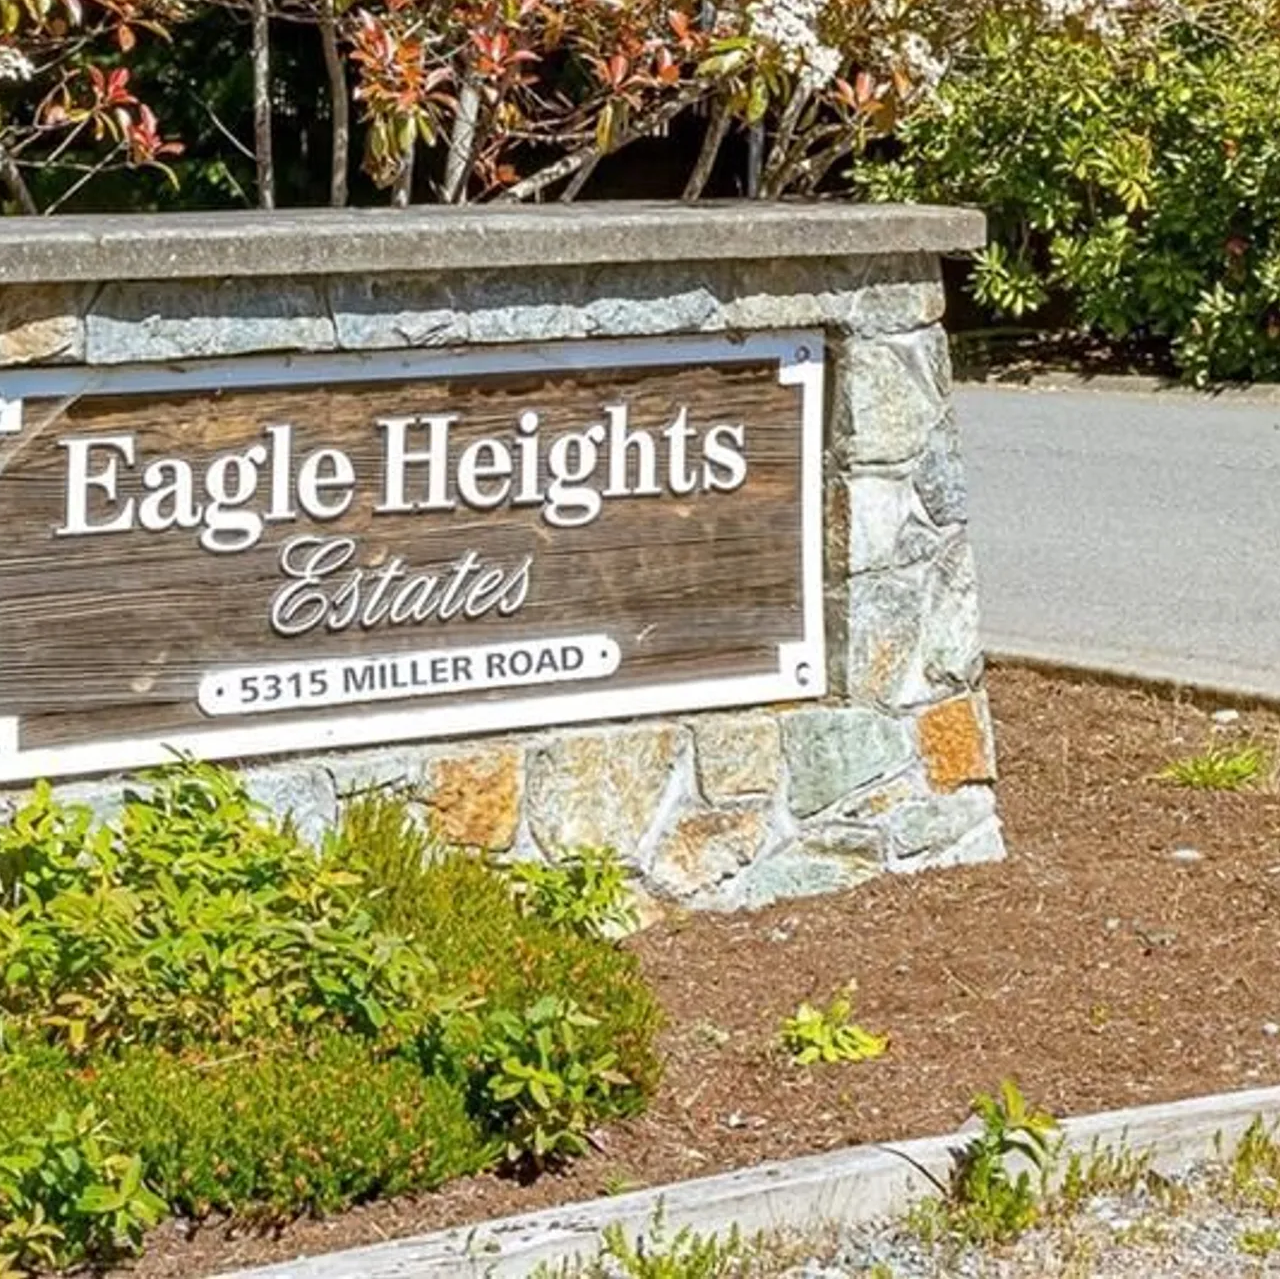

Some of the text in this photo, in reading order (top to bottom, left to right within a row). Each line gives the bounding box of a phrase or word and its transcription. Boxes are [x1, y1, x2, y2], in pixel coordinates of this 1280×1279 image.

[55, 403, 748, 553] Eagle Heights
[272, 535, 534, 635] Estates
[239, 645, 585, 704] 5315 MILLER ROAD
